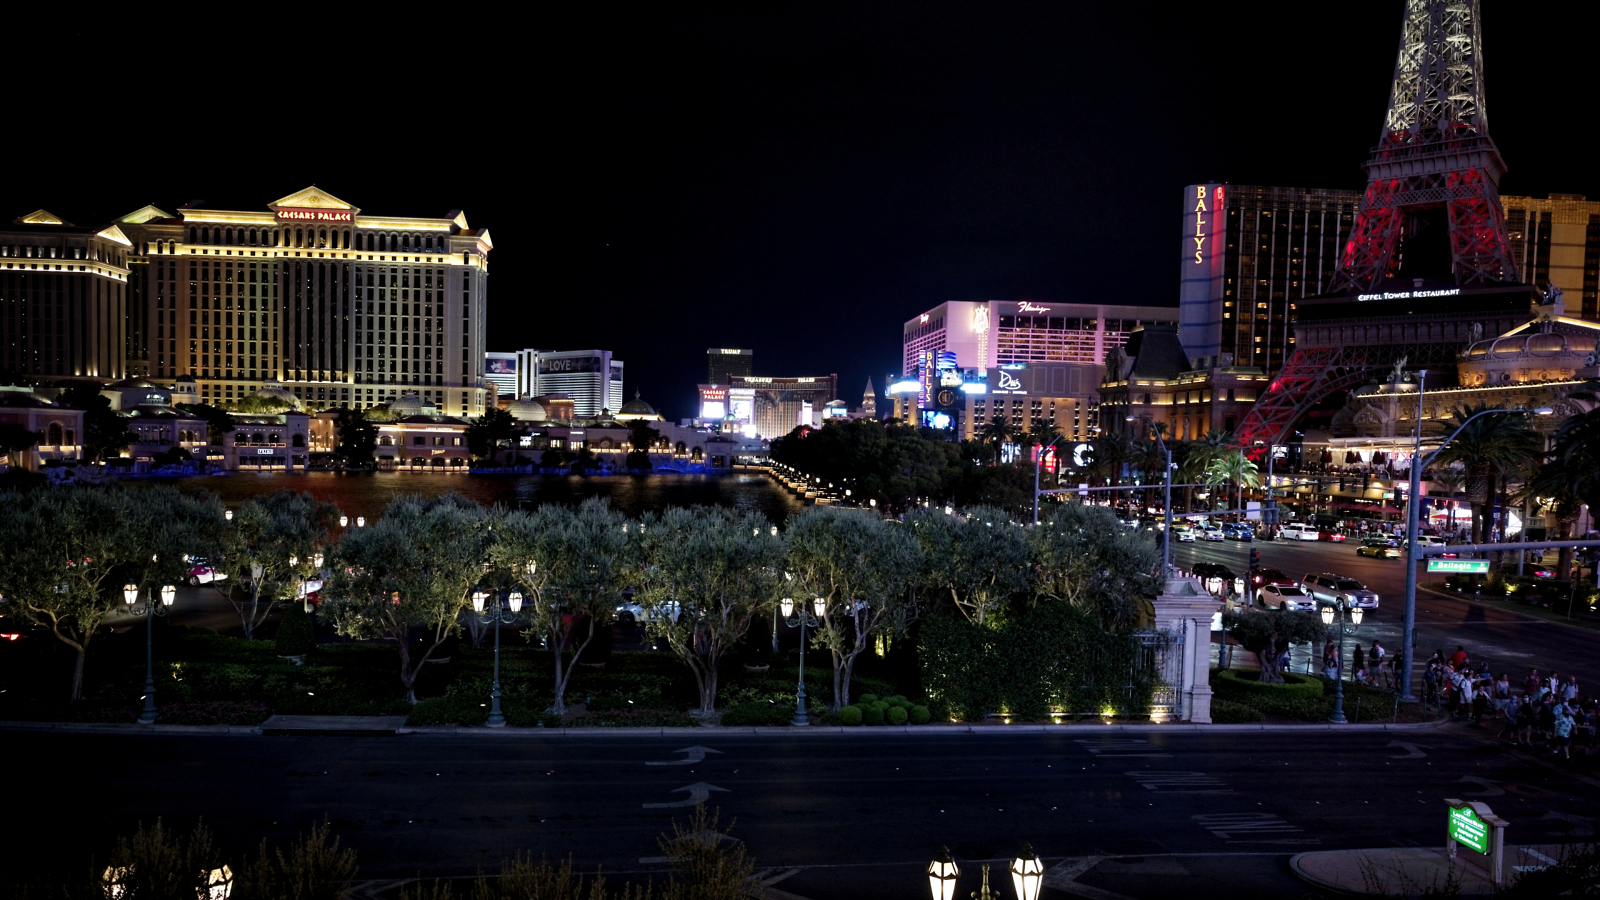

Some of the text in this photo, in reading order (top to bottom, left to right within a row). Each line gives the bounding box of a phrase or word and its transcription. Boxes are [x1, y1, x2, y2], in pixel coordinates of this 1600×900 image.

[278, 211, 350, 220] CAESARS PALACE
[1194, 186, 1207, 264] BALLYS
[1413, 288, 1460, 298] RESTAURANT
[1018, 301, 1050, 314] Flamingo
[549, 360, 571, 372] LOVE
[1438, 561, 1471, 570] Bellagio
